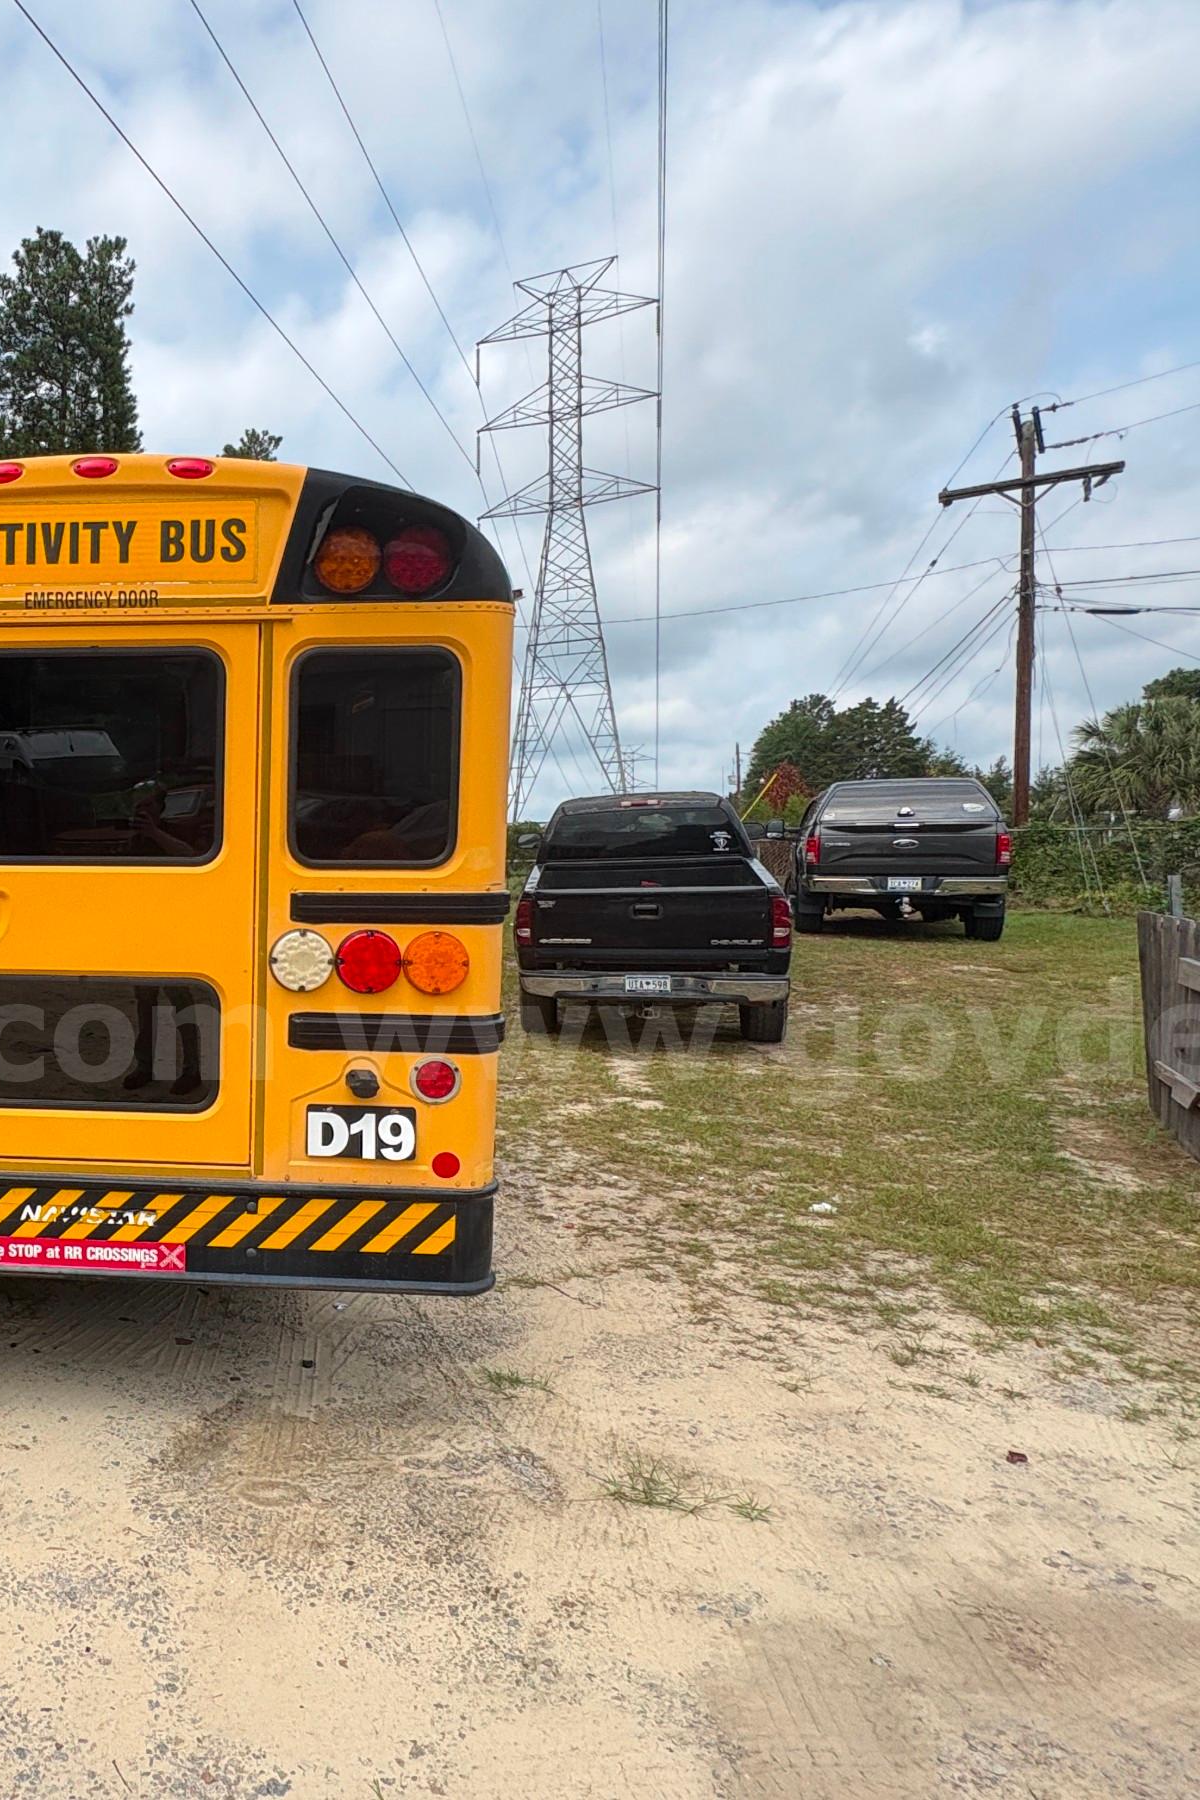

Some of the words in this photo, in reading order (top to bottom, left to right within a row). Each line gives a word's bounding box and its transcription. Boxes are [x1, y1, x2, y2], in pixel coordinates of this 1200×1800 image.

[160, 518, 247, 563] BUS
[25, 590, 114, 609] EMERGENCY
[117, 589, 159, 608] DOOR
[307, 1111, 416, 1161] D19
[8, 1244, 42, 1258] STOP
[46, 1246, 60, 1259] at
[64, 1245, 83, 1260] RR
[86, 1246, 158, 1263] CROSSINGS
